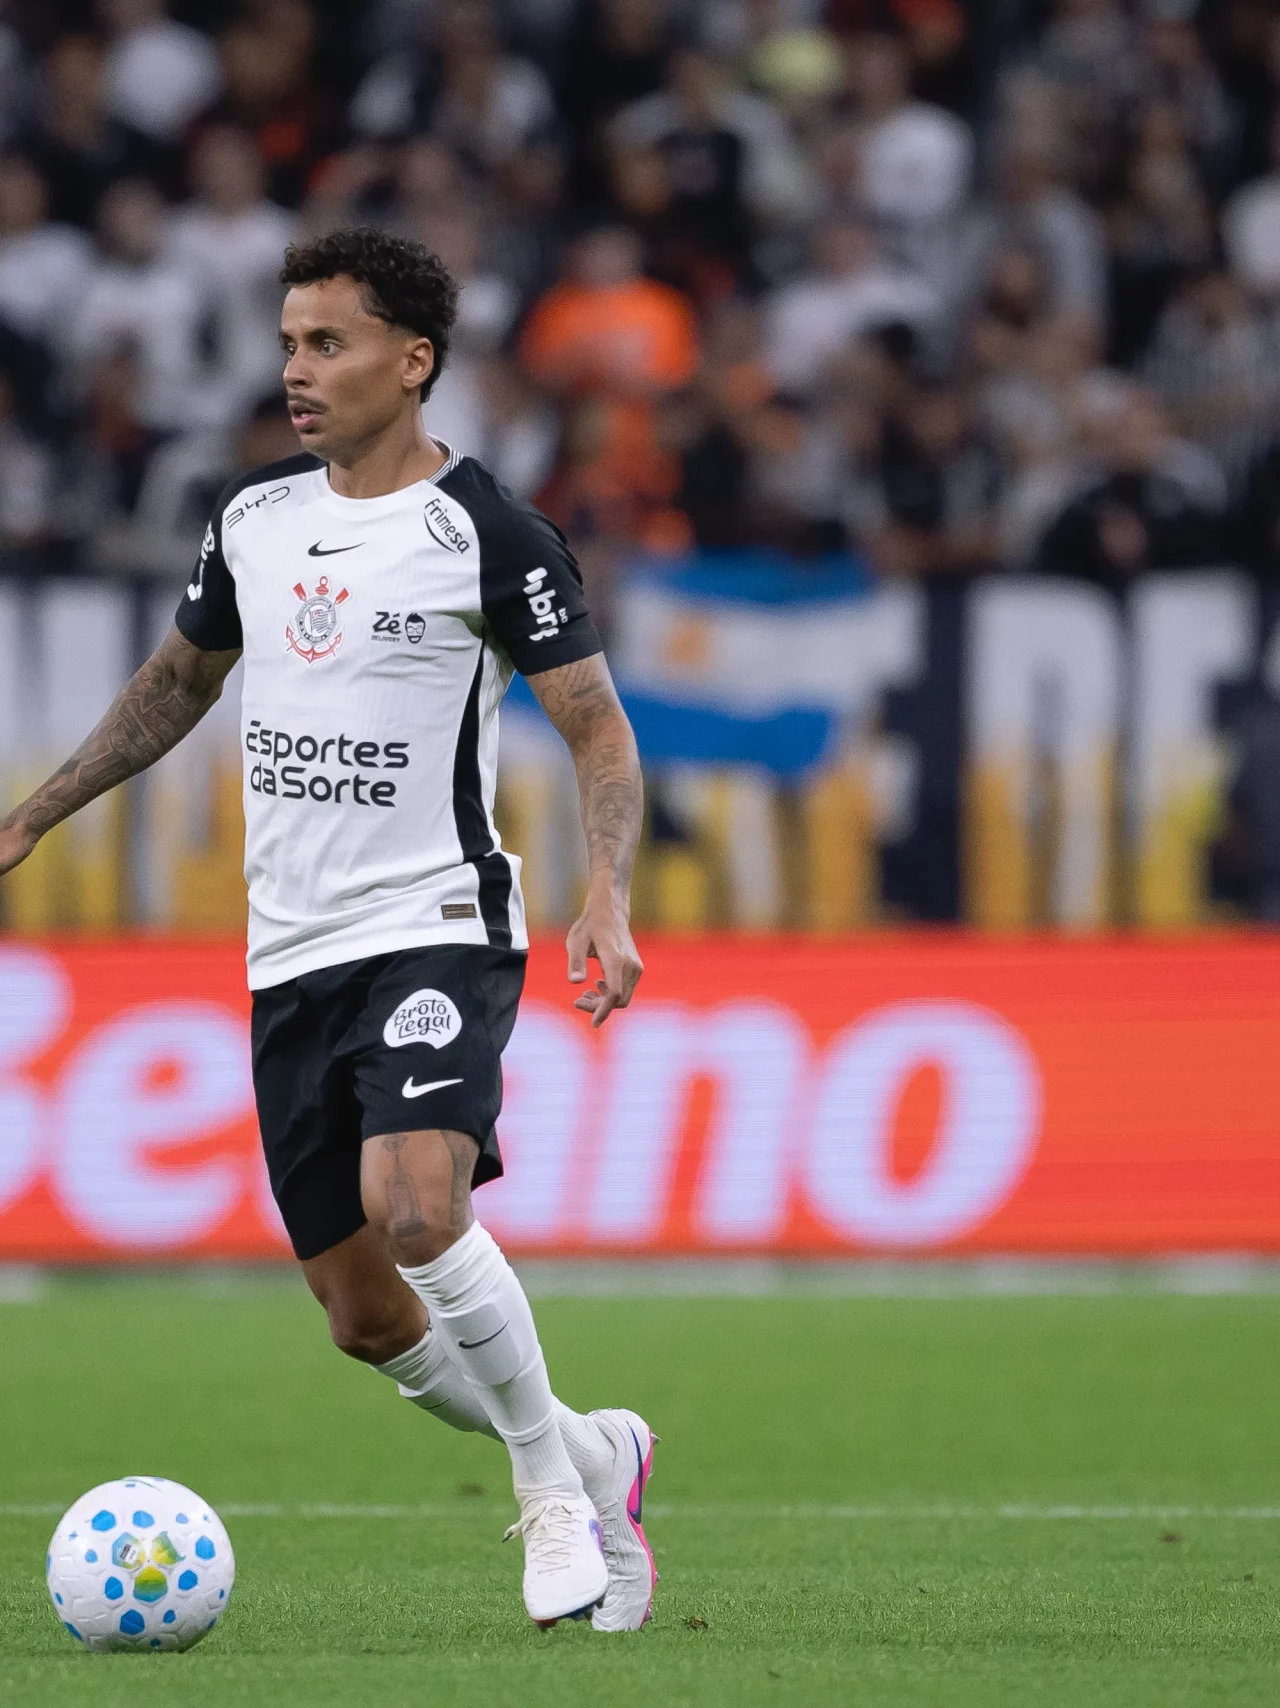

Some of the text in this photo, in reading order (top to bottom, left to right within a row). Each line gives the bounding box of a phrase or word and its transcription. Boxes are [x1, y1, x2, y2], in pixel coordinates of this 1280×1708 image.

[225, 485, 291, 530] BYD
[424, 498, 470, 554] Frimesa
[372, 611, 402, 635] Zé
[246, 720, 410, 769] Esportes
[393, 998, 447, 1028] Broto
[399, 1014, 451, 1039] Legal
